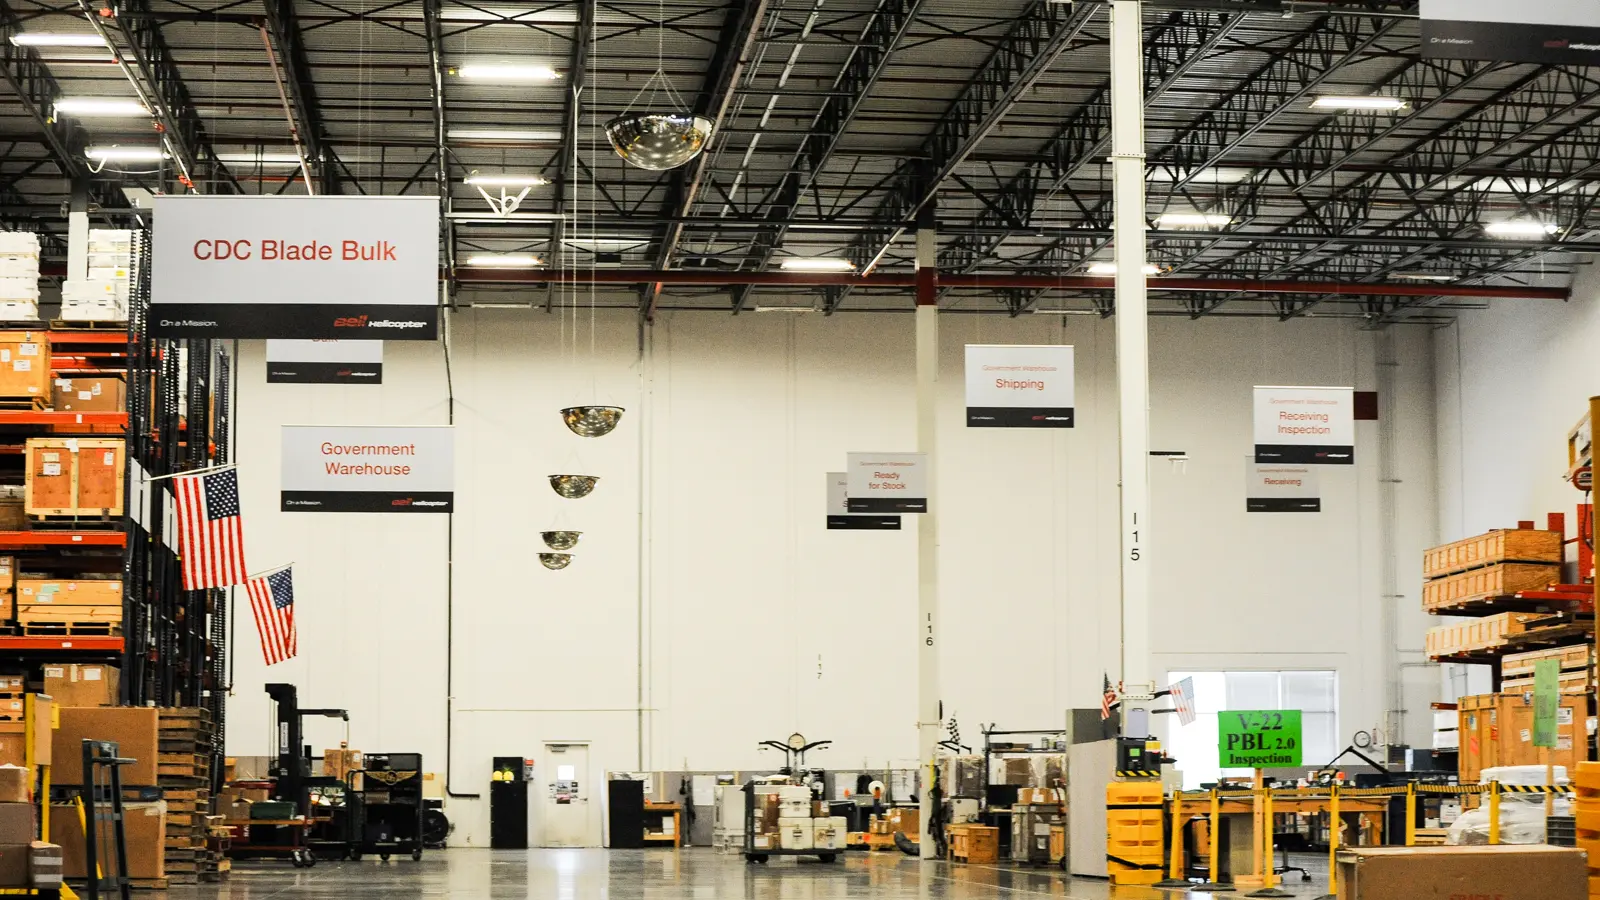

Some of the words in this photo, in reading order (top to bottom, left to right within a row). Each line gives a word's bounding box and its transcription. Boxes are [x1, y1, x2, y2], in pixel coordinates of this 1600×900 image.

[193, 239, 251, 261] CDC
[261, 239, 333, 261] Blade
[341, 240, 397, 261] Bulk
[995, 378, 1045, 391] Shipping
[1279, 411, 1329, 423] Receiving
[1277, 424, 1331, 436] Inspection
[320, 441, 415, 456] Government
[325, 462, 411, 476] Warehouse
[873, 471, 900, 480] Ready
[868, 481, 880, 490] for
[882, 481, 906, 490] Stock
[1263, 477, 1302, 487] Receiving
[1238, 713, 1283, 730] V-22
[1226, 733, 1271, 750] PBL
[1275, 737, 1296, 750] 2.0
[1229, 753, 1292, 767] Inspection
